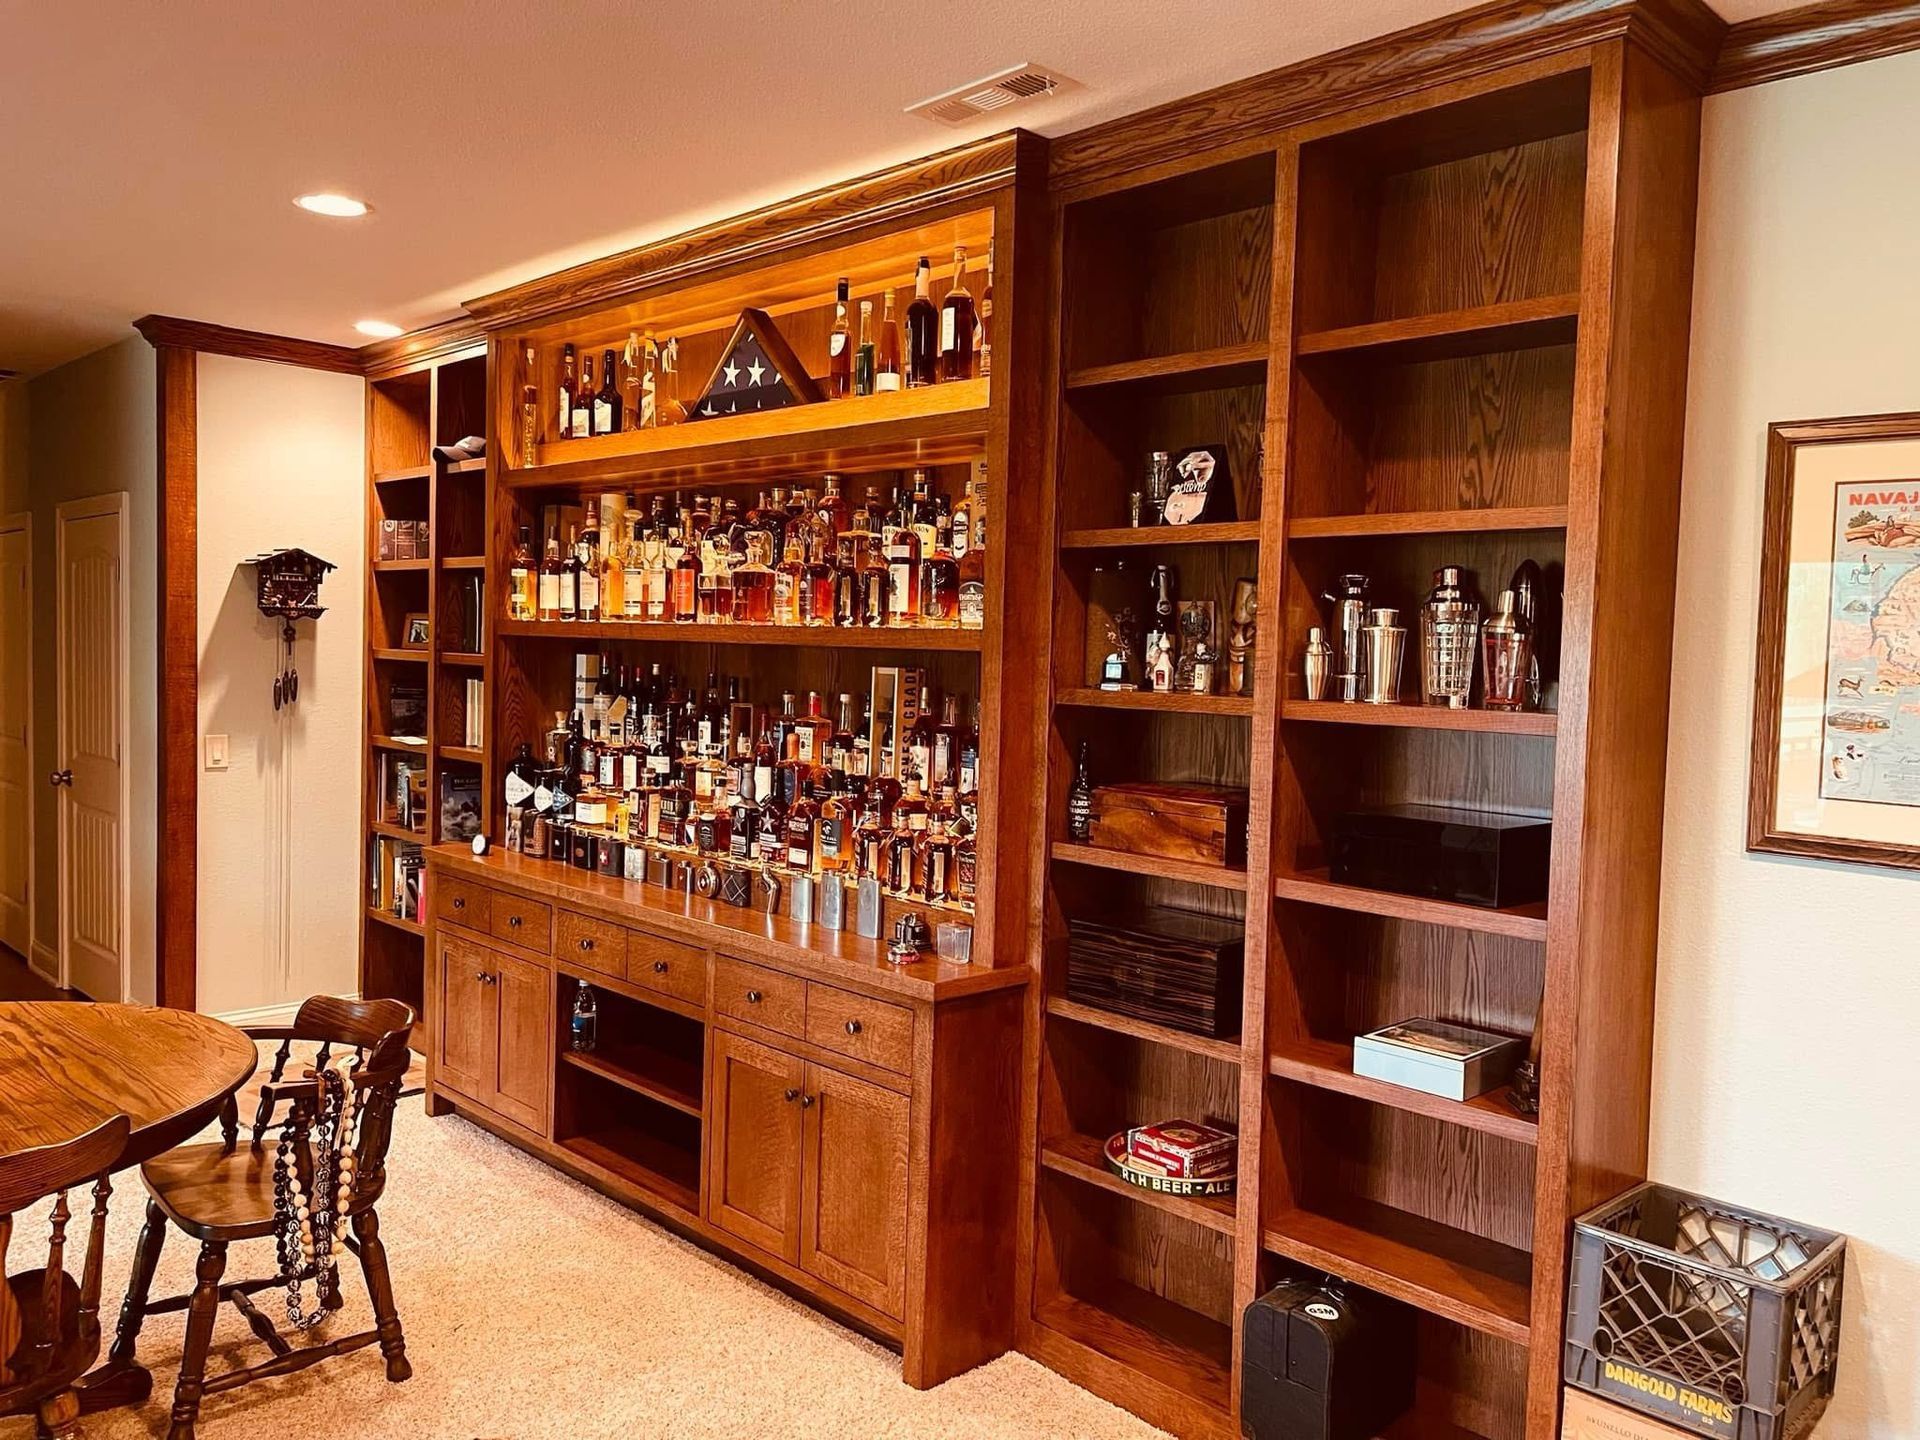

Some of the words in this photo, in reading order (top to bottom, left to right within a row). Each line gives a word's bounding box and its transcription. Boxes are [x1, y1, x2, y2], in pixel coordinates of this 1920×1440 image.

[1152, 1177, 1192, 1195] BEER
[1205, 1182, 1230, 1194] ALE
[1605, 1361, 1677, 1402] DARIGOLD
[1678, 1387, 1734, 1424] FARMS
